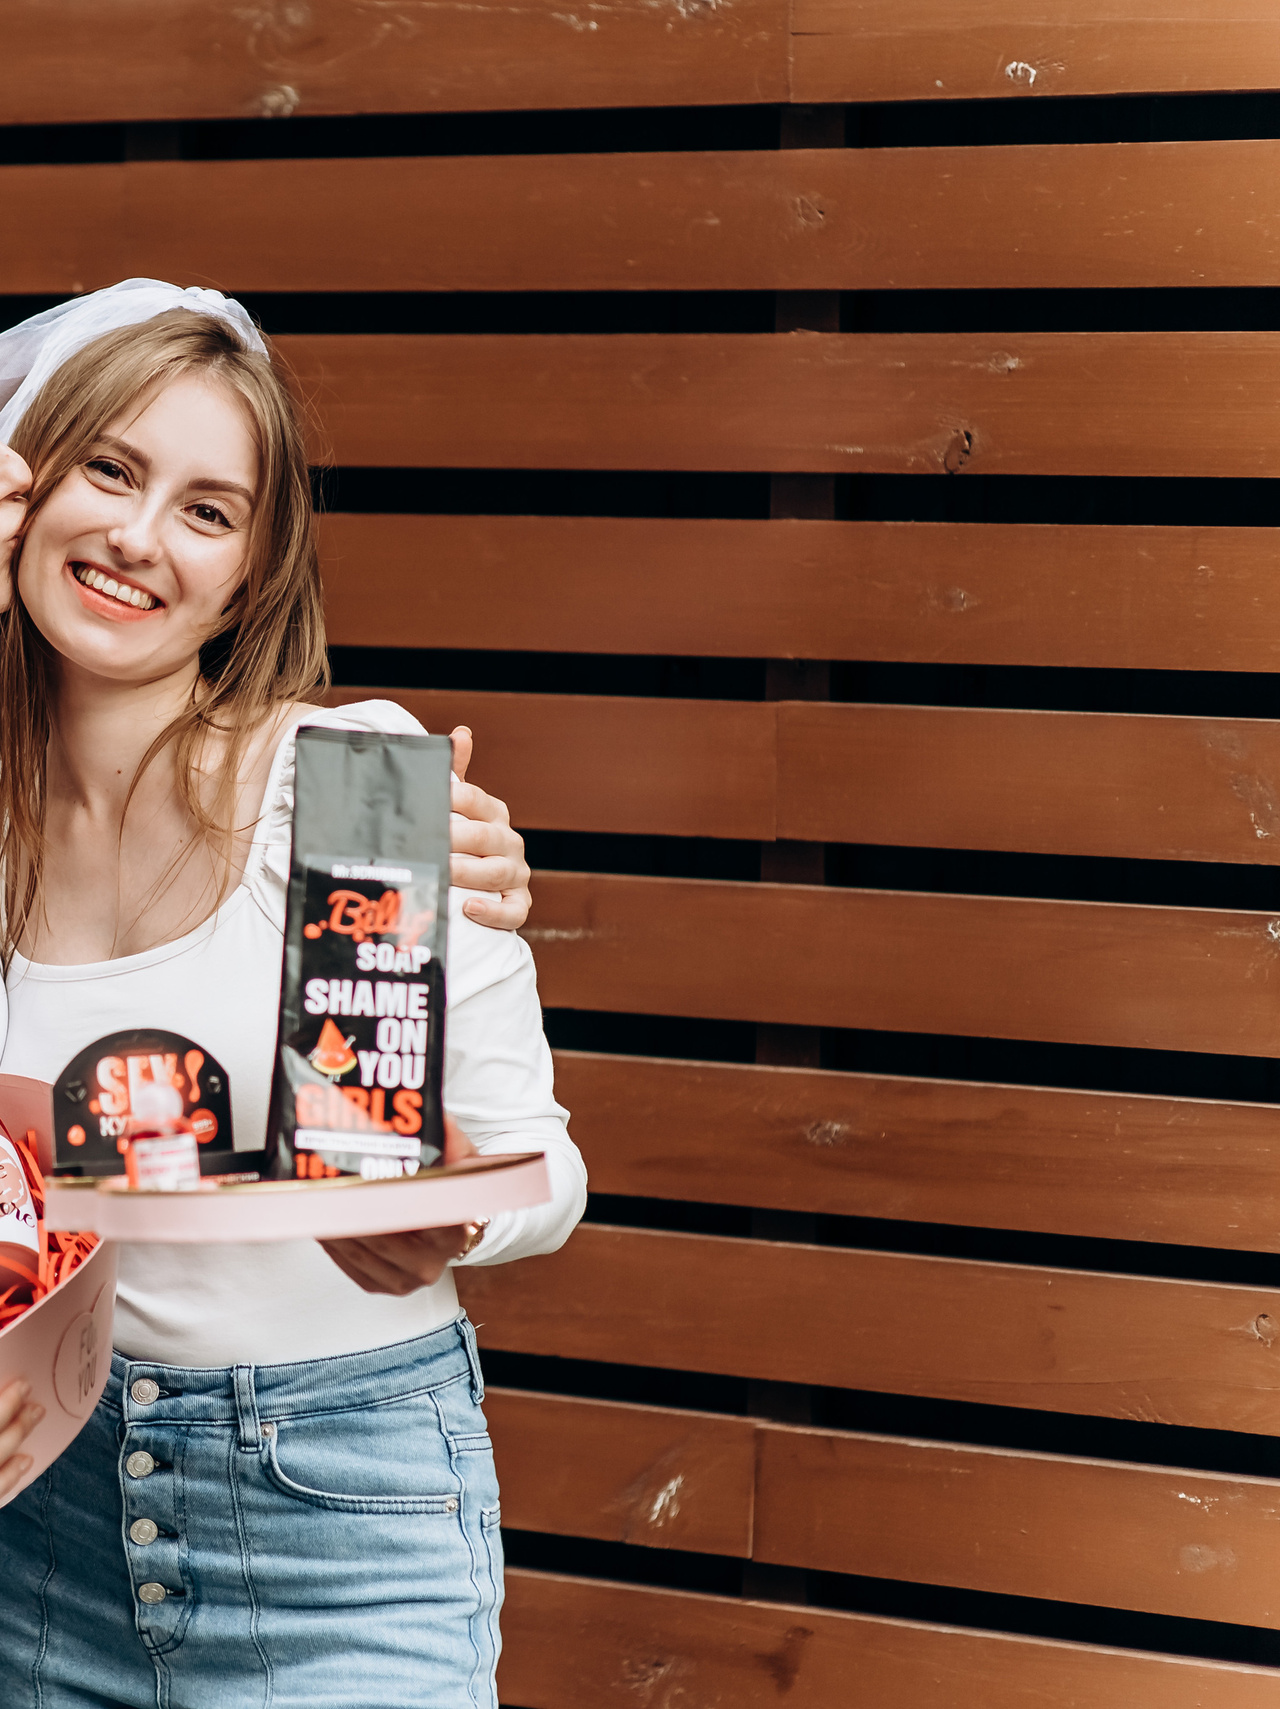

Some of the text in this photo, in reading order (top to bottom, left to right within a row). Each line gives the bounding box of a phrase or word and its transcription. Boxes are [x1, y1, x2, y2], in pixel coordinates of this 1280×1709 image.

[356, 942, 431, 974] SOAP
[304, 978, 430, 1020] SHAME
[376, 1017, 428, 1055] ON
[357, 1050, 426, 1090] YOU
[295, 1084, 423, 1135] GIRLS
[77, 1352, 97, 1405] YOU
